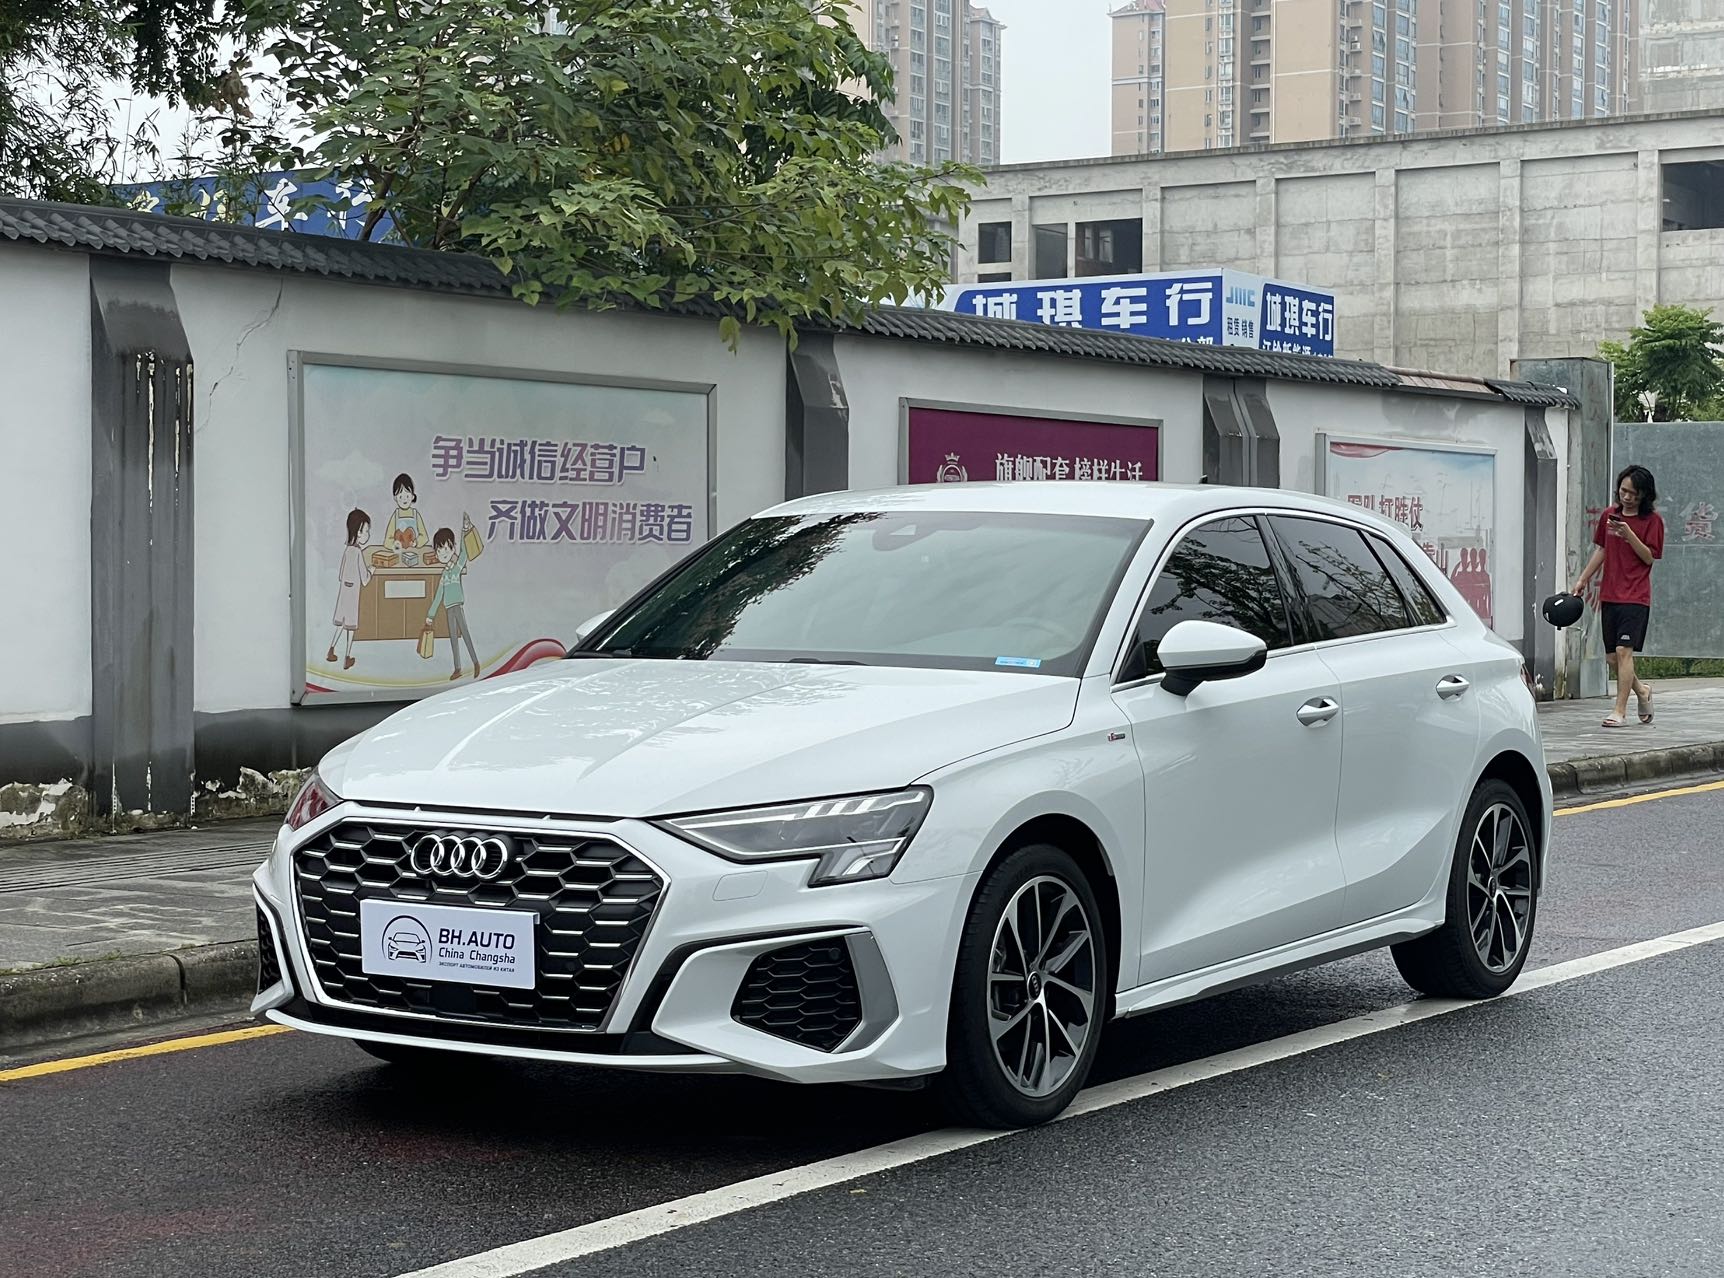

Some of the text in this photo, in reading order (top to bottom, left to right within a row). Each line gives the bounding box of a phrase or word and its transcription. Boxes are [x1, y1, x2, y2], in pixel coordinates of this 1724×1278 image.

[431, 435, 646, 484] 争当诚信经营户
[487, 499, 692, 543] 齐做文明消费者
[438, 928, 515, 950] BH.AUTO
[439, 947, 516, 965] China Changsha
